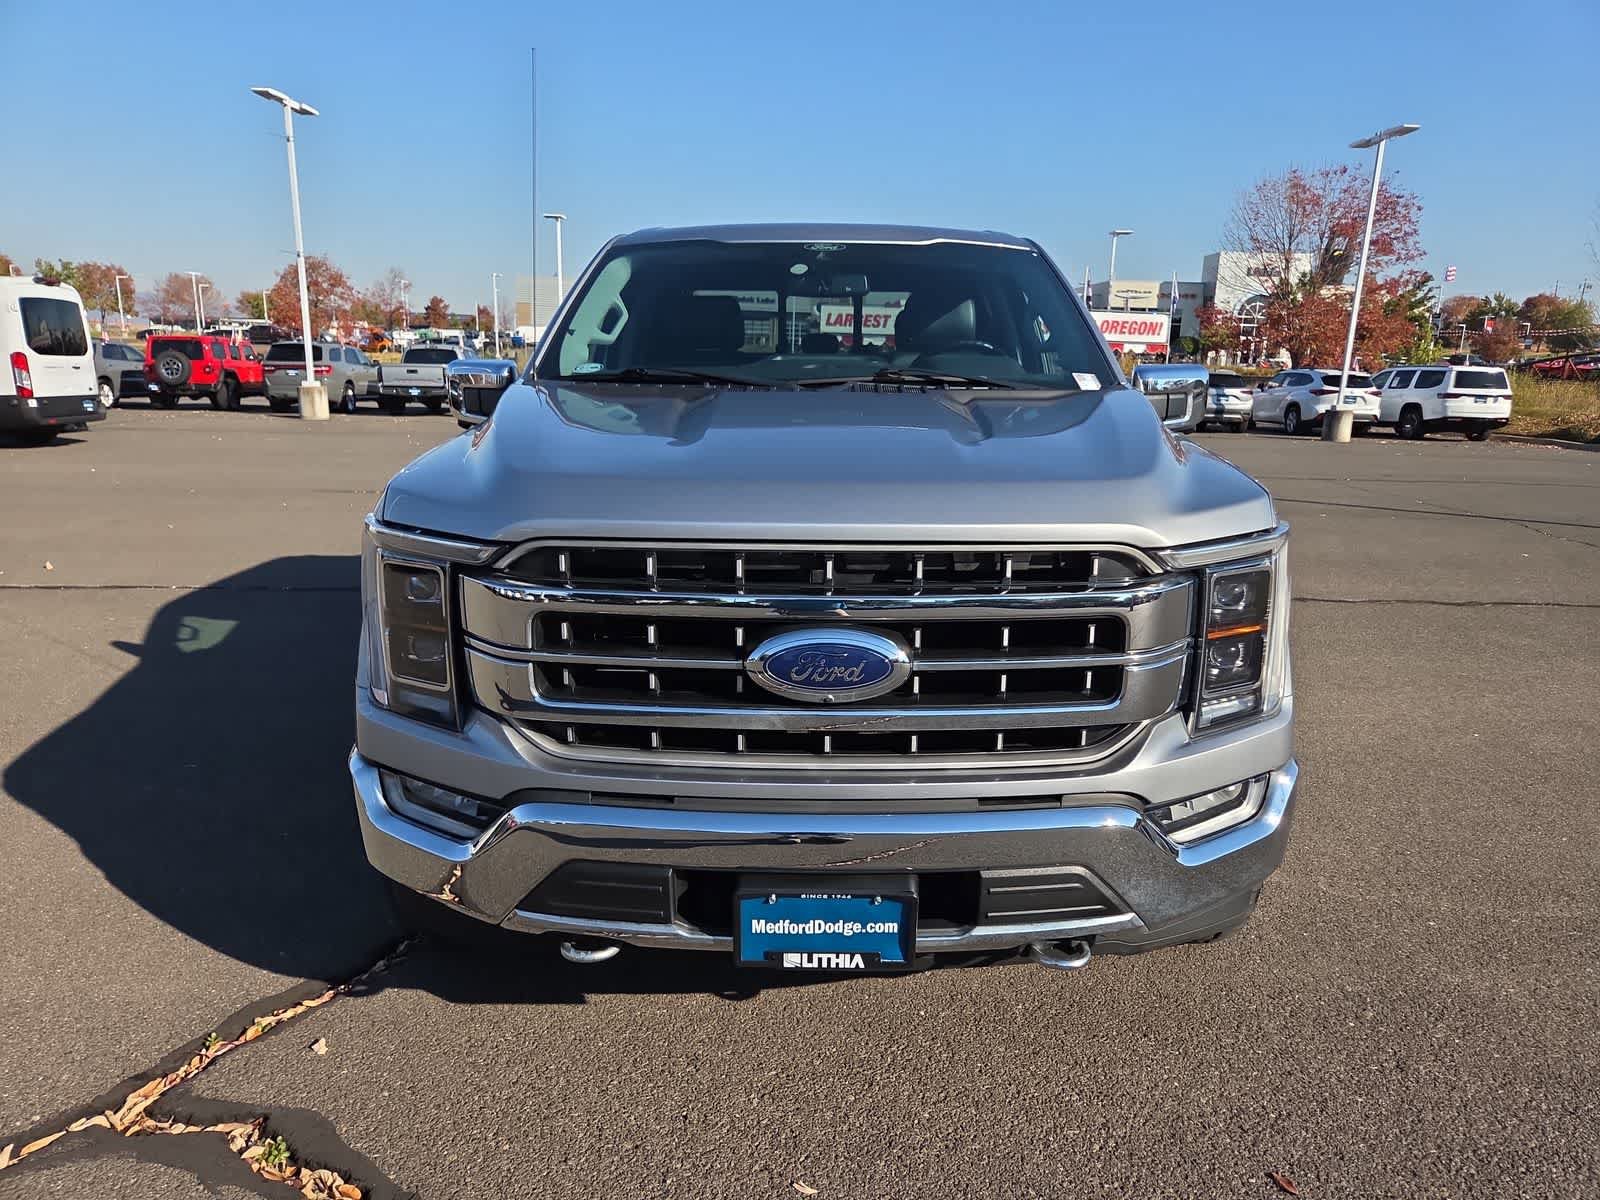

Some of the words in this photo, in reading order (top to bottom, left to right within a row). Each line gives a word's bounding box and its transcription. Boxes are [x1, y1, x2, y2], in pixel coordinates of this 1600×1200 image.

[825, 313, 891, 329] LAREST
[1100, 319, 1164, 336] OREGON!
[790, 651, 867, 682] Ford
[751, 919, 899, 936] MedfordDodge.com
[801, 953, 865, 968] LITHIA
